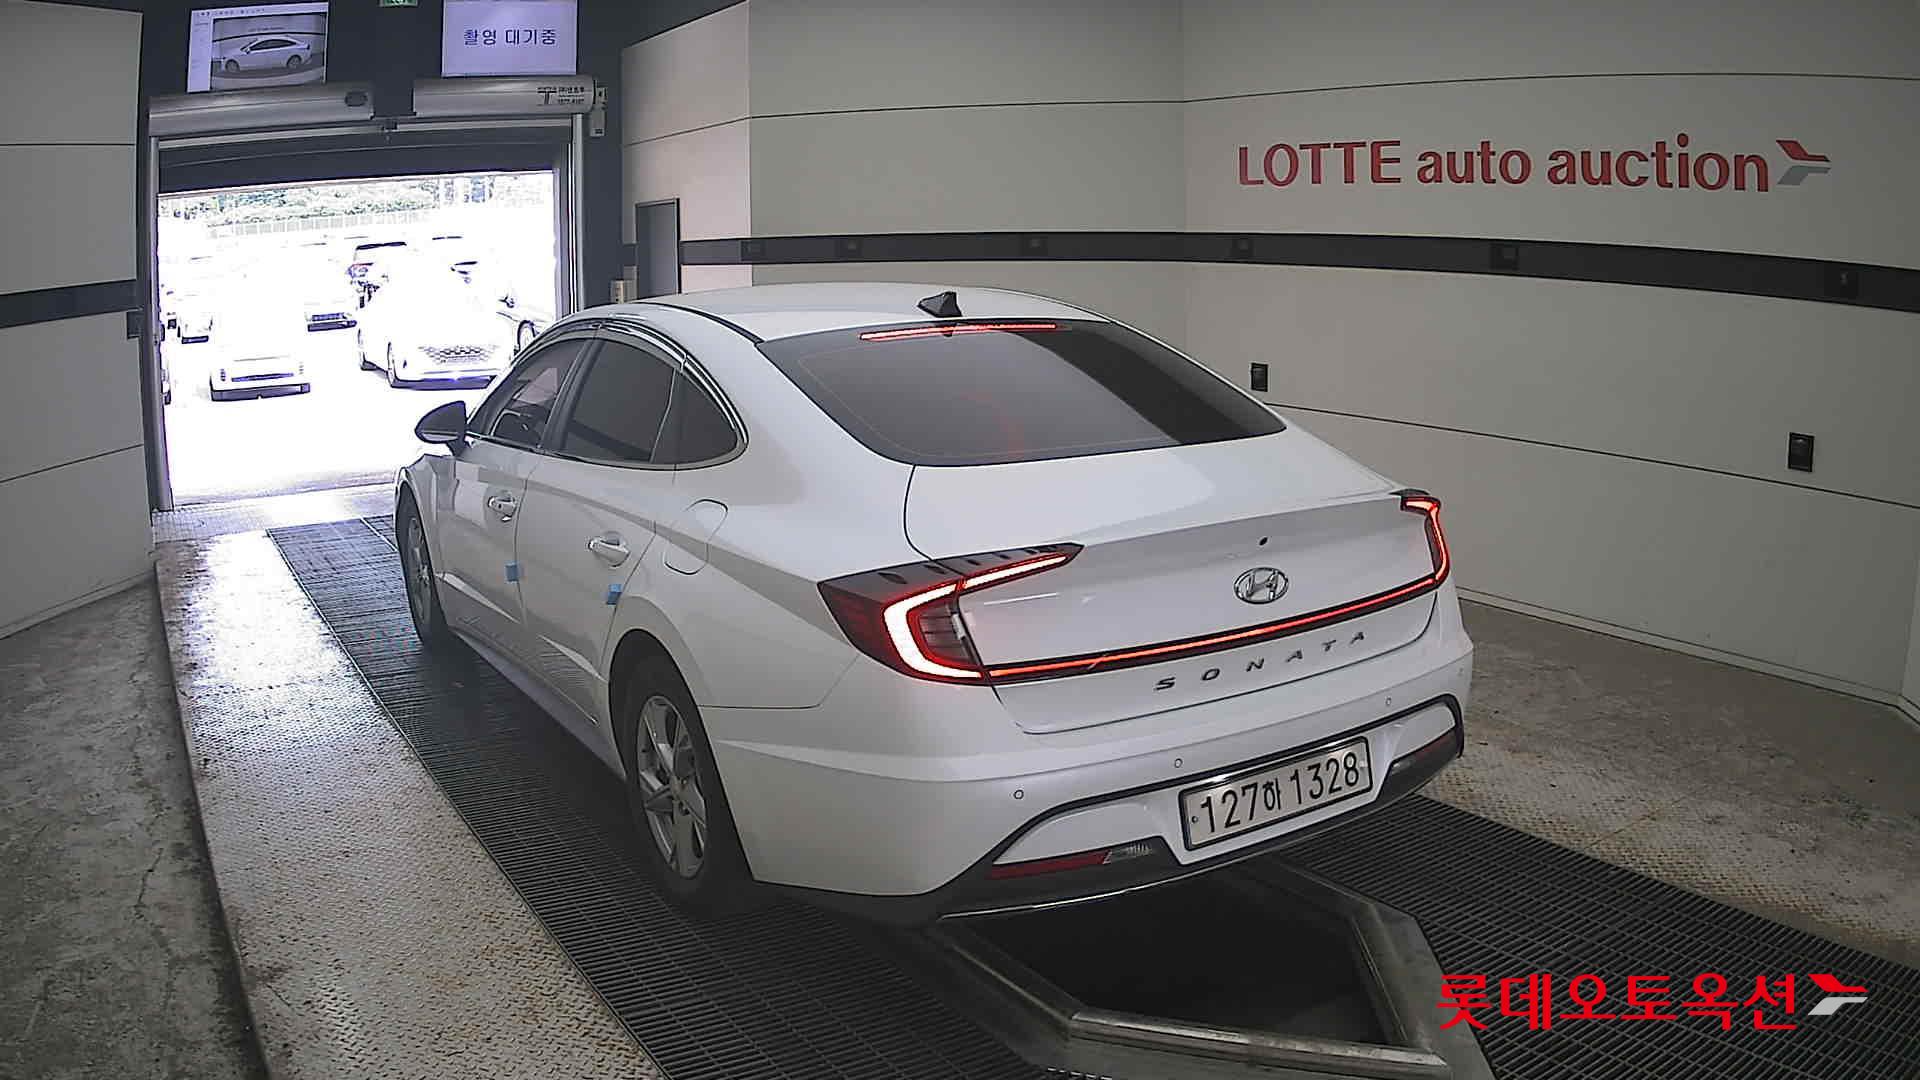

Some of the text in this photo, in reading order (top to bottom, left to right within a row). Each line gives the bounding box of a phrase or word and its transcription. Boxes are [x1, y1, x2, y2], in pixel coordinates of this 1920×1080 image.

[505, 29, 556, 45] 대기중
[1239, 132, 1769, 193] LOTTE auto auction
[1154, 631, 1365, 691] SONATA
[1289, 751, 1360, 805] 1328
